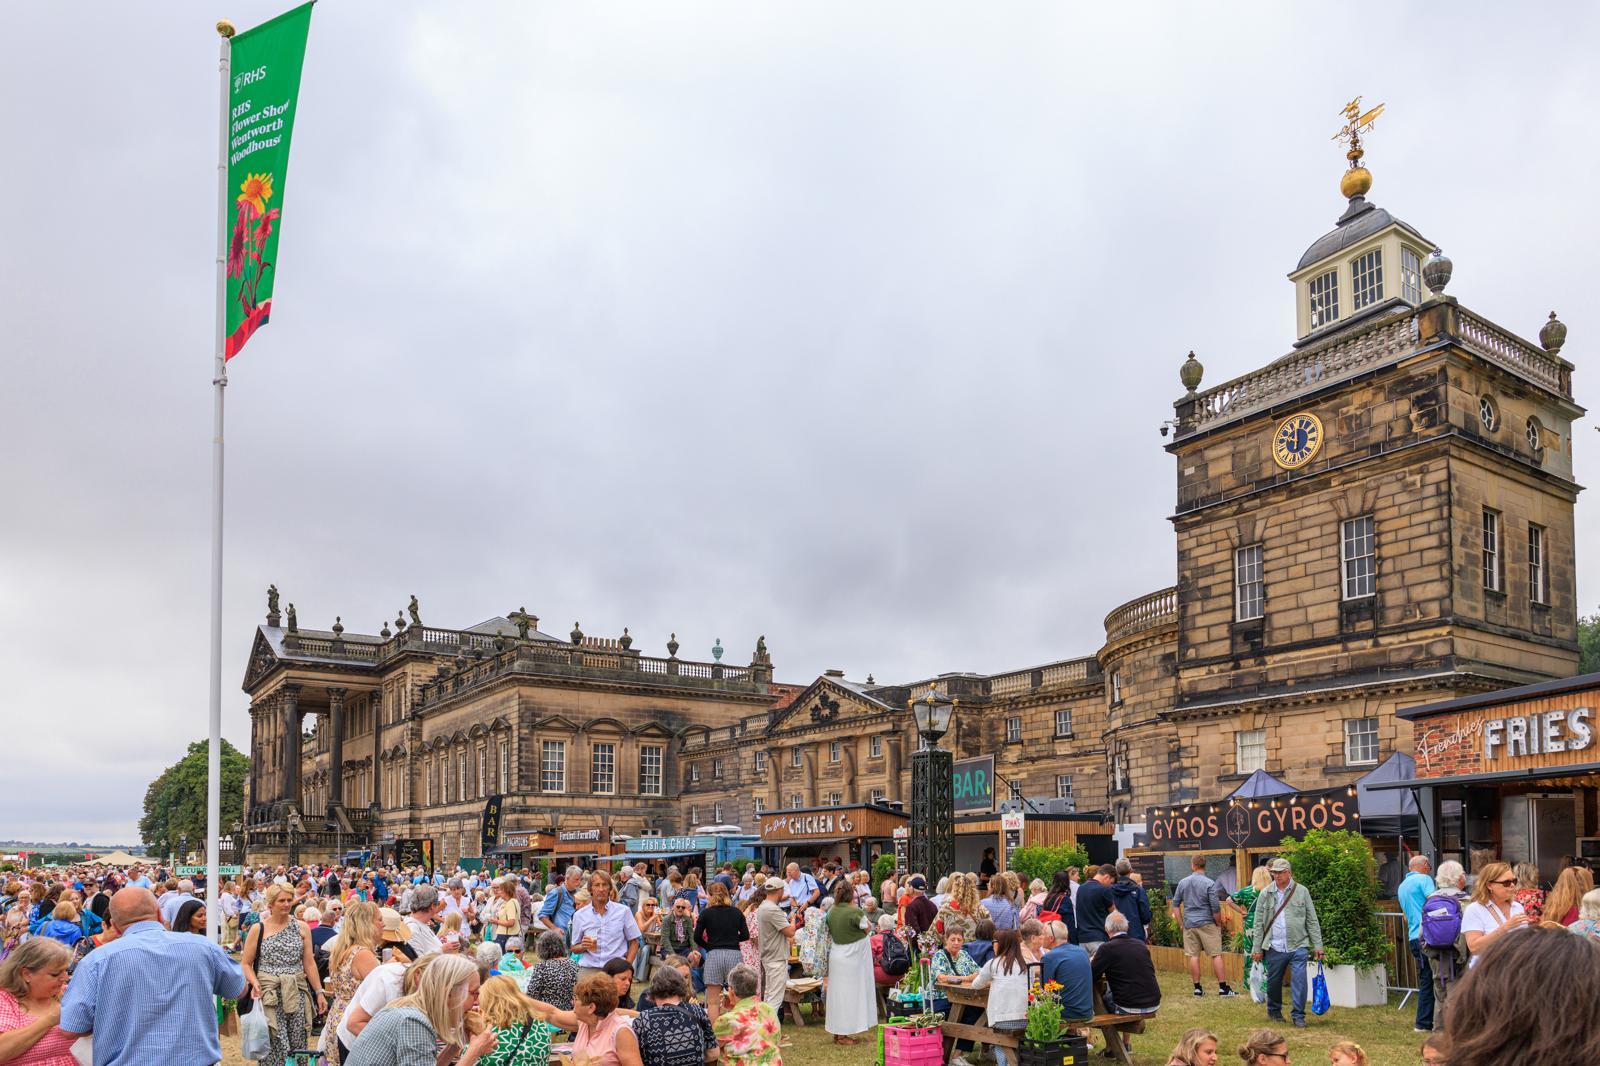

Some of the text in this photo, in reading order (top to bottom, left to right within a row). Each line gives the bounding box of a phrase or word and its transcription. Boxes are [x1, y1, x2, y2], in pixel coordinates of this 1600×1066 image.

[243, 65, 267, 86] RHS
[232, 99, 251, 120] RHS
[232, 98, 290, 137] Flower Show
[232, 117, 283, 150] Wentworth
[1417, 715, 1486, 772] Frenchies
[1485, 706, 1594, 760] FRIES
[953, 769, 986, 798] BAR
[487, 805, 497, 837] BAR
[788, 815, 834, 835] CHICKEN
[839, 814, 854, 832] Co
[1152, 815, 1219, 840] GYROS
[1257, 801, 1347, 833] GYROS
[661, 838, 667, 849] &
